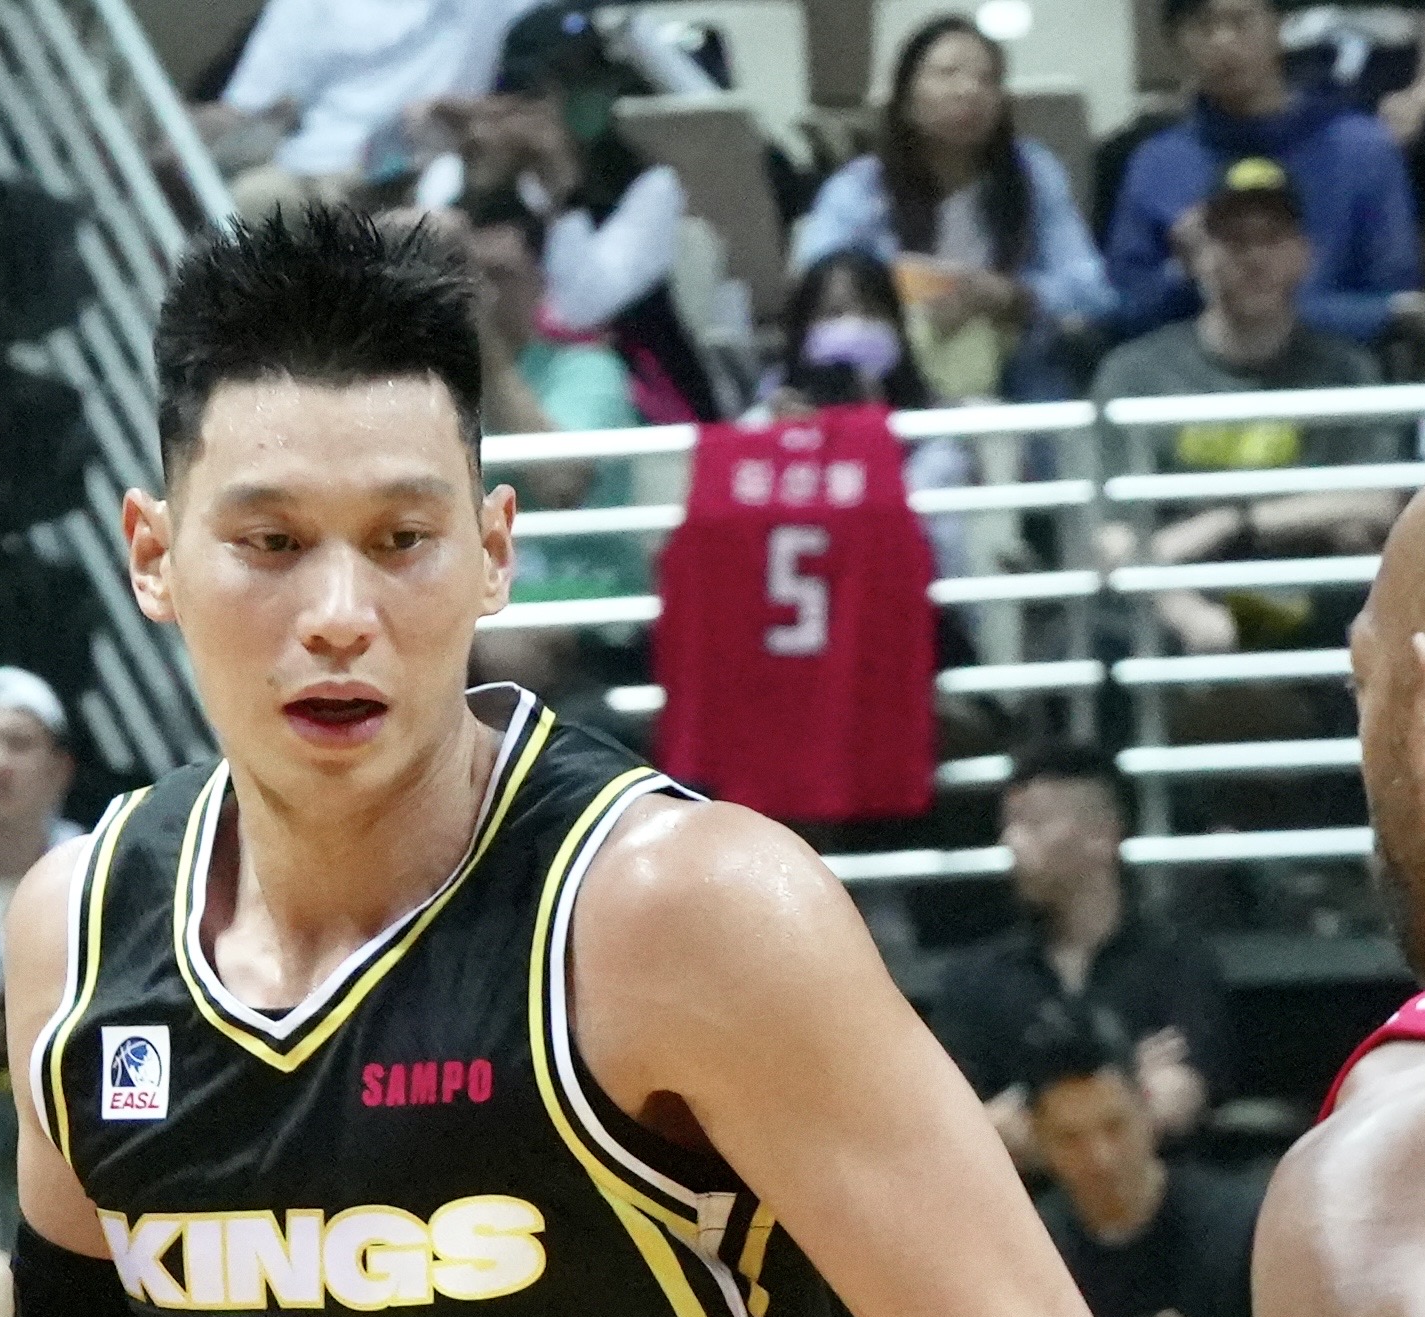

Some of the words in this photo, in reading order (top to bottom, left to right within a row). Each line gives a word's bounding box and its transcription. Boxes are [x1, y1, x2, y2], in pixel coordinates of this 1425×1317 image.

[763, 524, 831, 657] 5
[109, 1091, 160, 1110] EASL
[361, 1058, 494, 1107] SAMPO
[96, 1193, 547, 1312] KINGS
